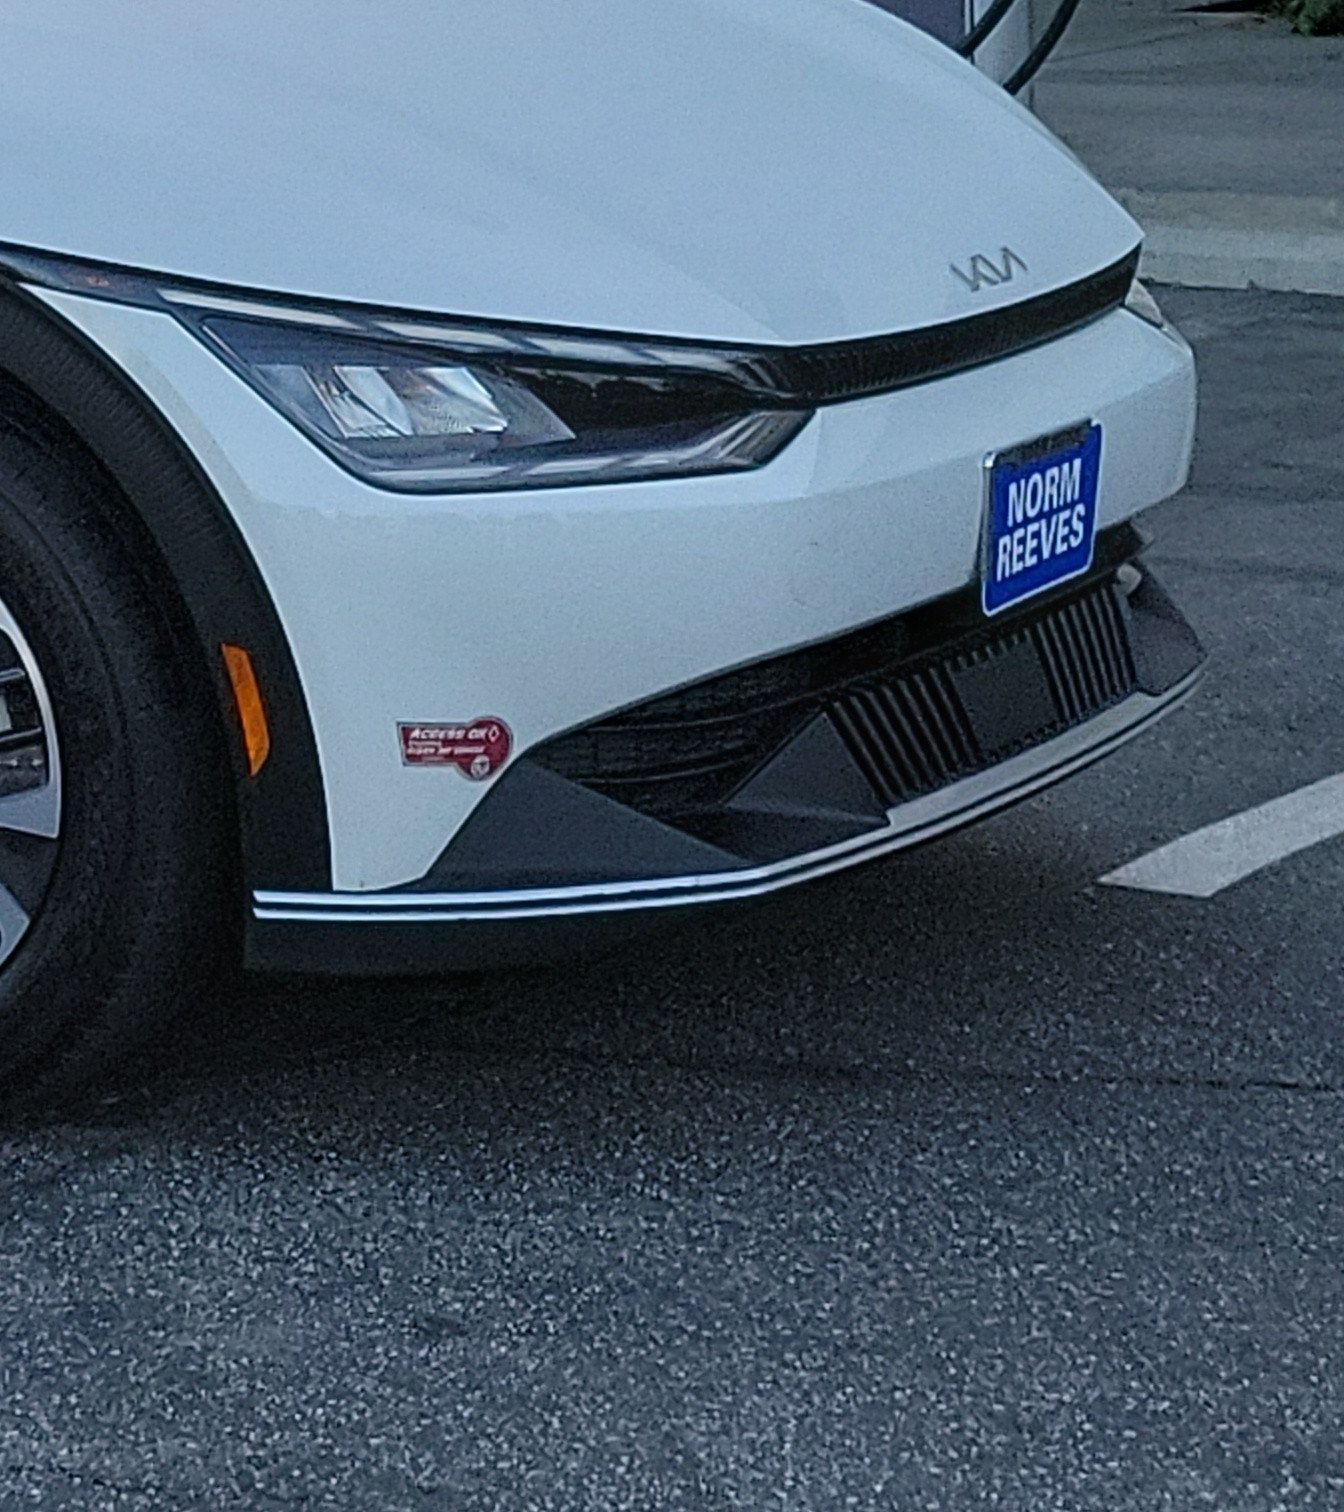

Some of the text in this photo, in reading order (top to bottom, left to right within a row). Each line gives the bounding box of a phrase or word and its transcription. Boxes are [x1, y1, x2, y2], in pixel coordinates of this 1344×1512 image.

[949, 245, 1028, 293] KIA
[1007, 458, 1082, 528] NORM
[996, 503, 1086, 582] REEVES
